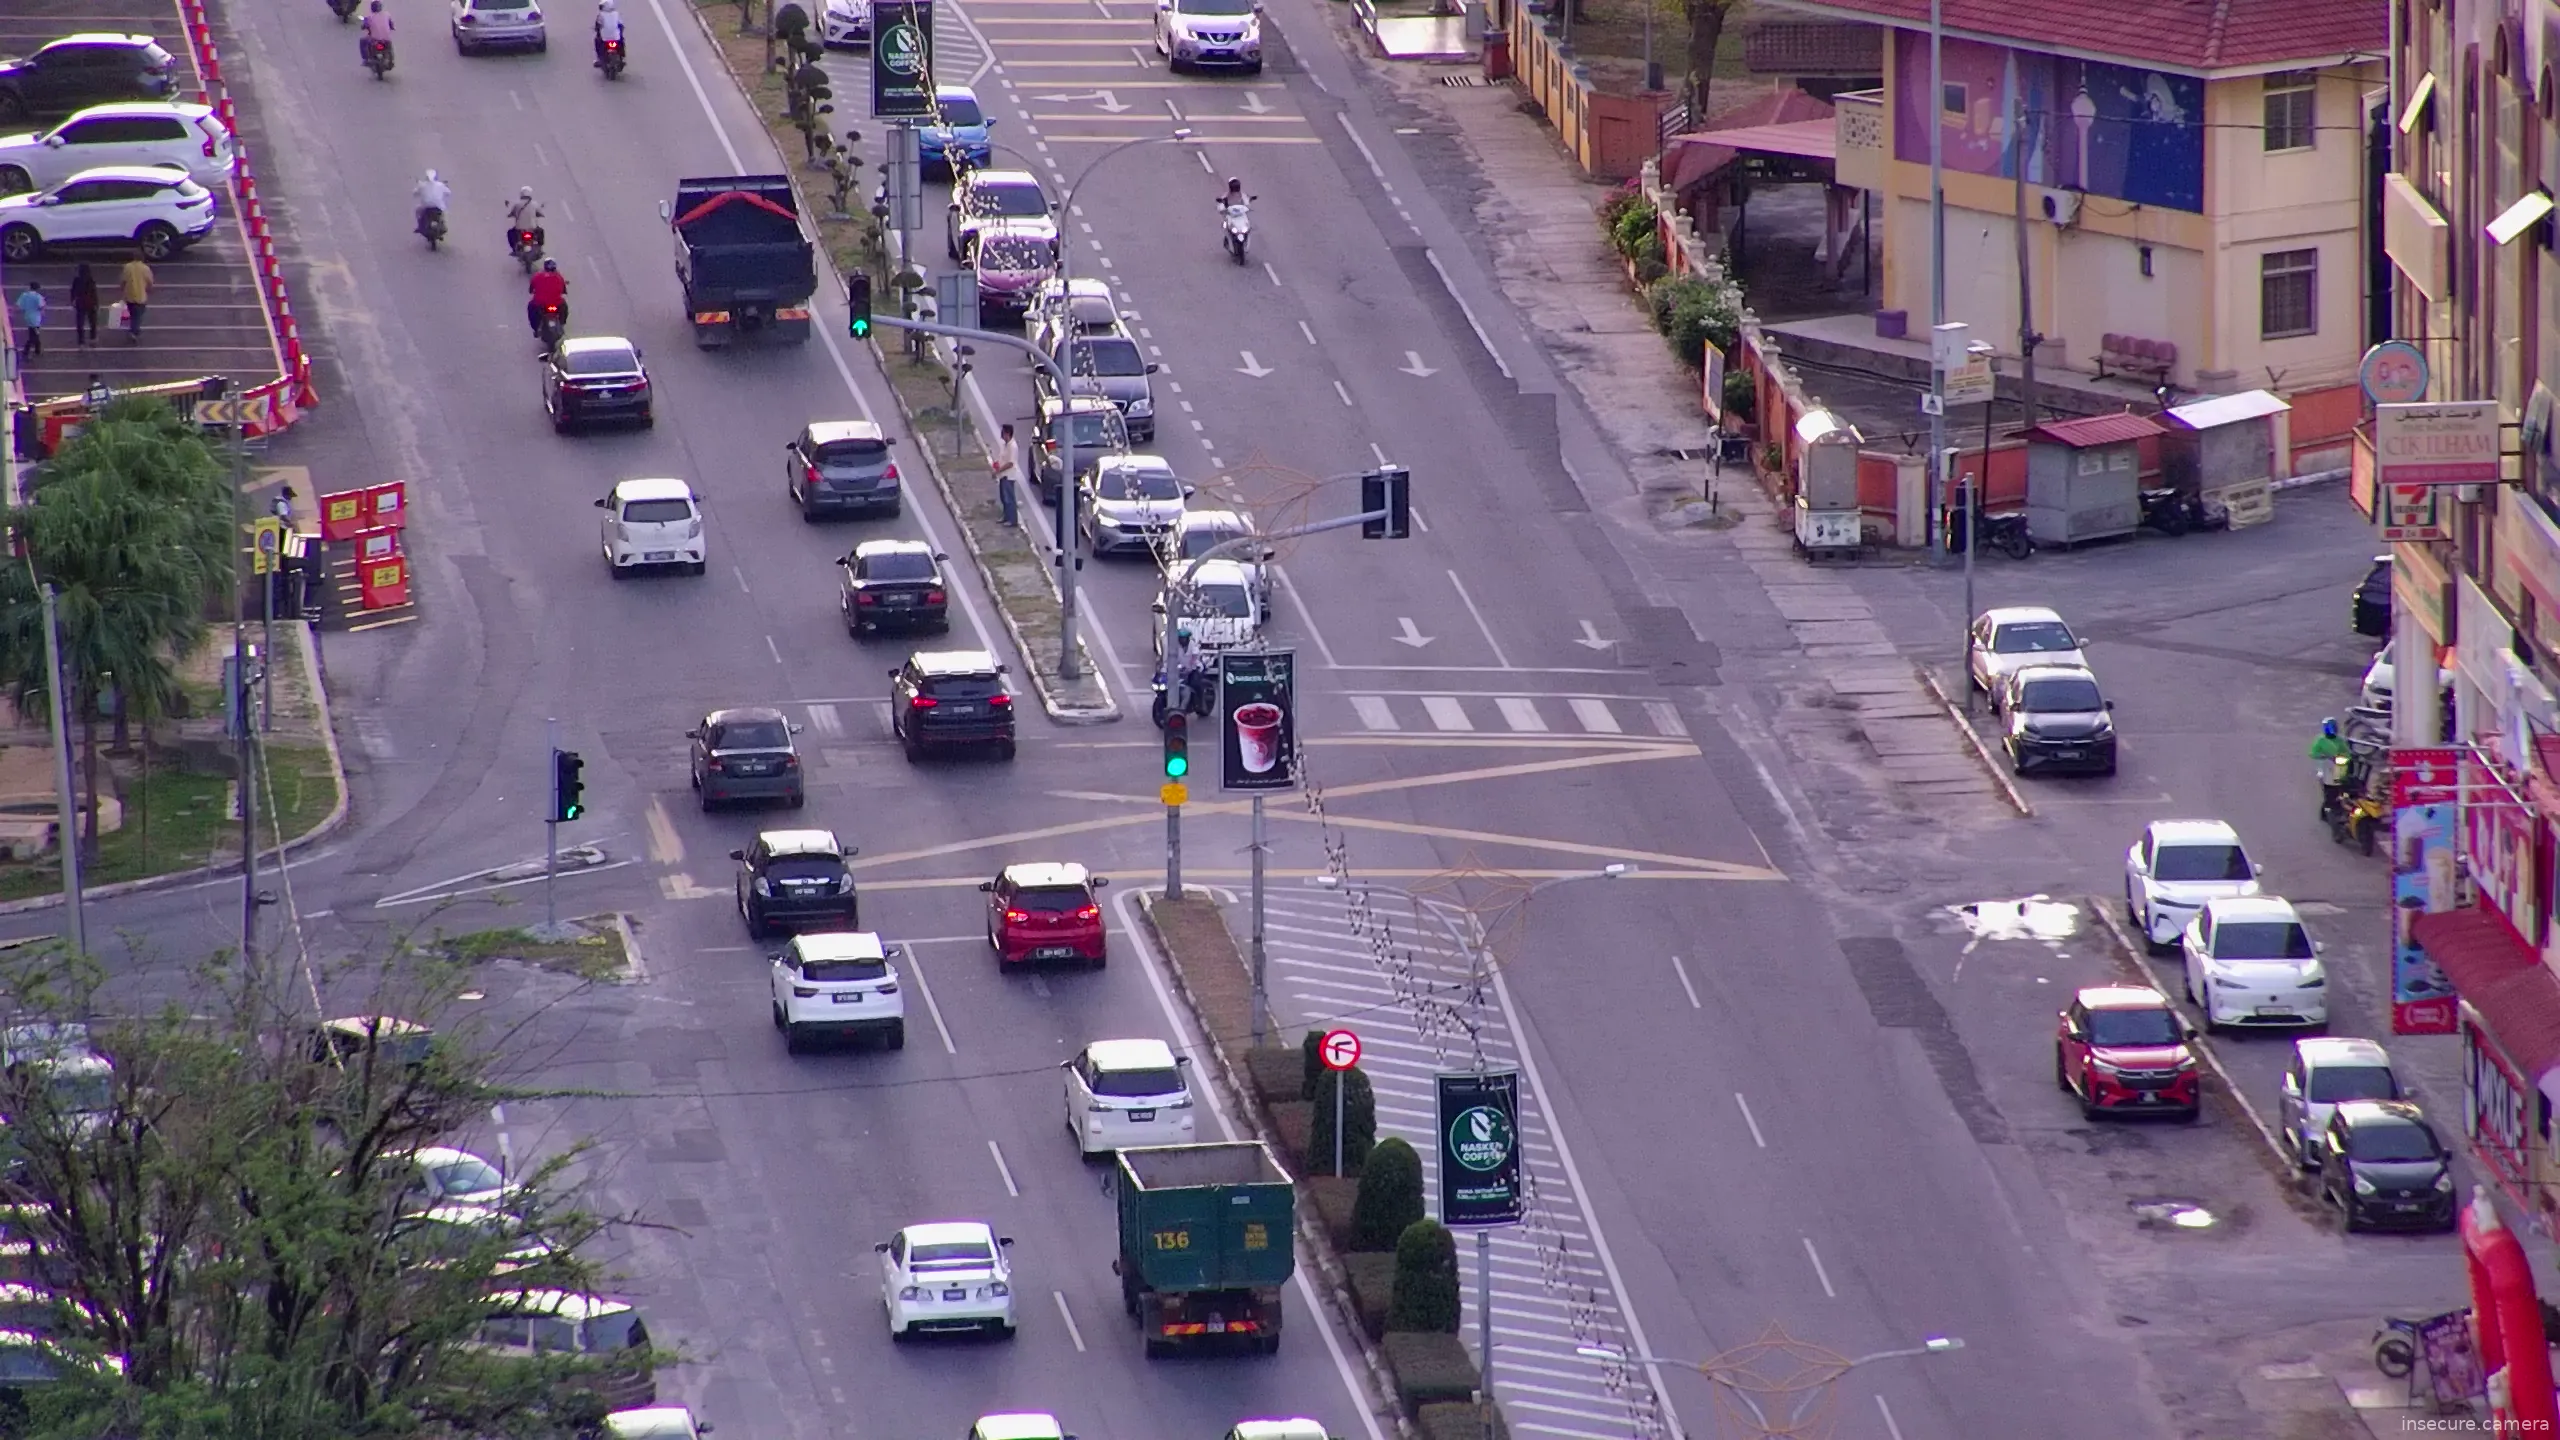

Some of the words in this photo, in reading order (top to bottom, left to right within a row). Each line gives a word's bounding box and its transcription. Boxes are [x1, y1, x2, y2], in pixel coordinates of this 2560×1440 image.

[2385, 435, 2420, 456] CIK
[2426, 434, 2492, 455] ILHAM
[1460, 1141, 1504, 1152] NASKEN
[1153, 1231, 1190, 1250] 136
